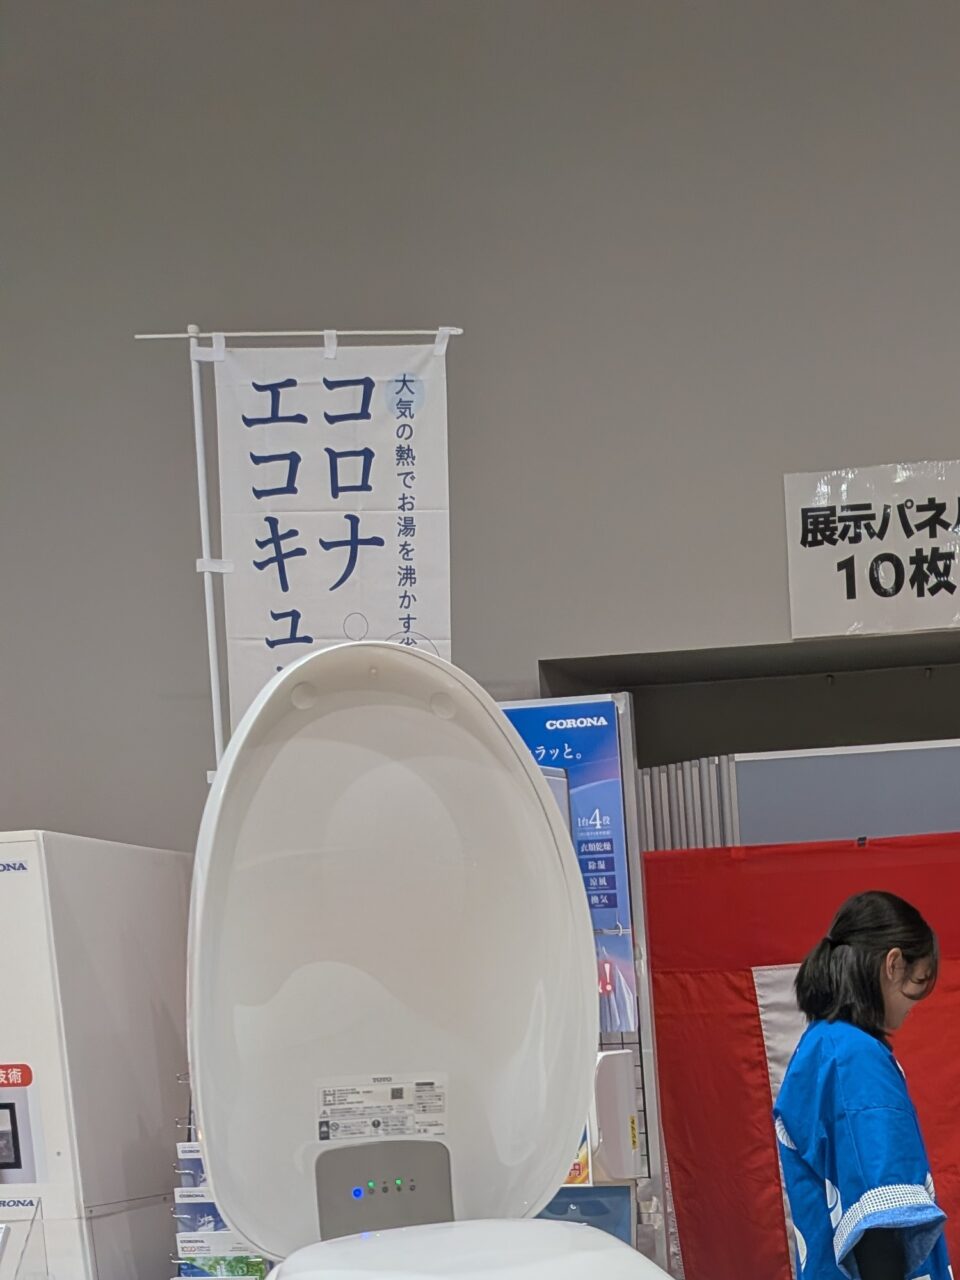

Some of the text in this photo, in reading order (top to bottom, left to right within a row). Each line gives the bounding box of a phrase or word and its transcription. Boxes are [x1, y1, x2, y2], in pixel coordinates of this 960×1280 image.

[318, 376, 386, 592] コロナ
[241, 378, 314, 673] エコキュ
[836, 546, 957, 600] 10枚
[545, 716, 608, 731] CORONA
[529, 743, 582, 761] ラッと。
